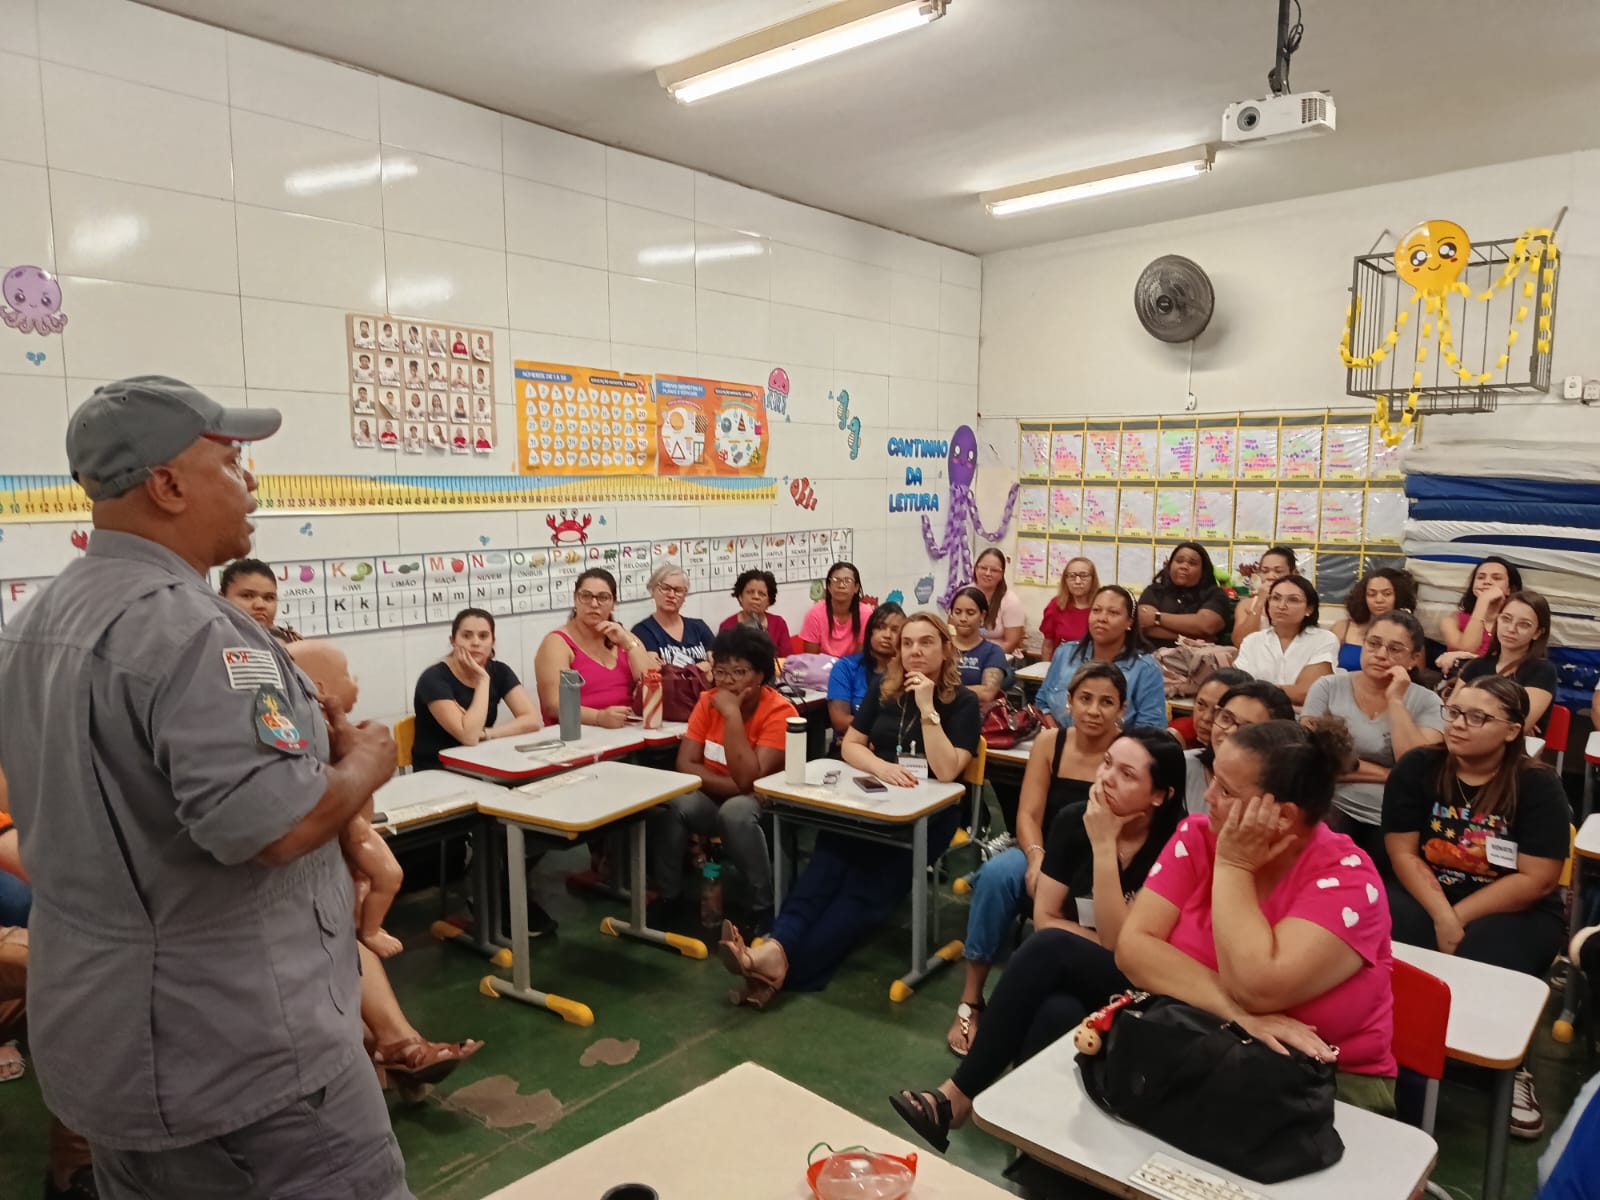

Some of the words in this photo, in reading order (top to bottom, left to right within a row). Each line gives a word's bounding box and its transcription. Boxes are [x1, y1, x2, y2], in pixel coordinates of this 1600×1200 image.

[887, 437, 948, 458] CANTINHO
[906, 467, 922, 486] DA
[10, 504, 19, 513] 10
[25, 504, 34, 512] 11
[40, 503, 49, 512] 12
[54, 503, 63, 512] 13
[68, 503, 77, 512] 14
[889, 493, 939, 513] LEITURA
[766, 537, 773, 547] W
[789, 535, 795, 545] X
[812, 533, 818, 543] Y
[833, 532, 840, 541] Z
[654, 544, 662, 555] S
[684, 542, 691, 553] T
[713, 540, 720, 550] U
[740, 539, 747, 549] V
[553, 550, 562, 562] P
[589, 547, 599, 560] Q
[623, 546, 632, 558] R
[430, 557, 445, 571] M
[472, 554, 484, 568] N
[514, 552, 525, 565] O
[332, 563, 346, 578] K
[383, 560, 394, 574] L
[278, 566, 288, 581] J
[392, 579, 416, 588] LIMÃO
[625, 575, 632, 584] R
[518, 585, 527, 594] O
[556, 581, 562, 590] P
[10, 583, 26, 600] F
[477, 587, 485, 597] N
[498, 587, 504, 595] n
[387, 596, 394, 606] L
[433, 592, 442, 603] M
[454, 592, 464, 600] m
[282, 603, 289, 614] J
[334, 598, 346, 611] K
[360, 597, 369, 609] k
